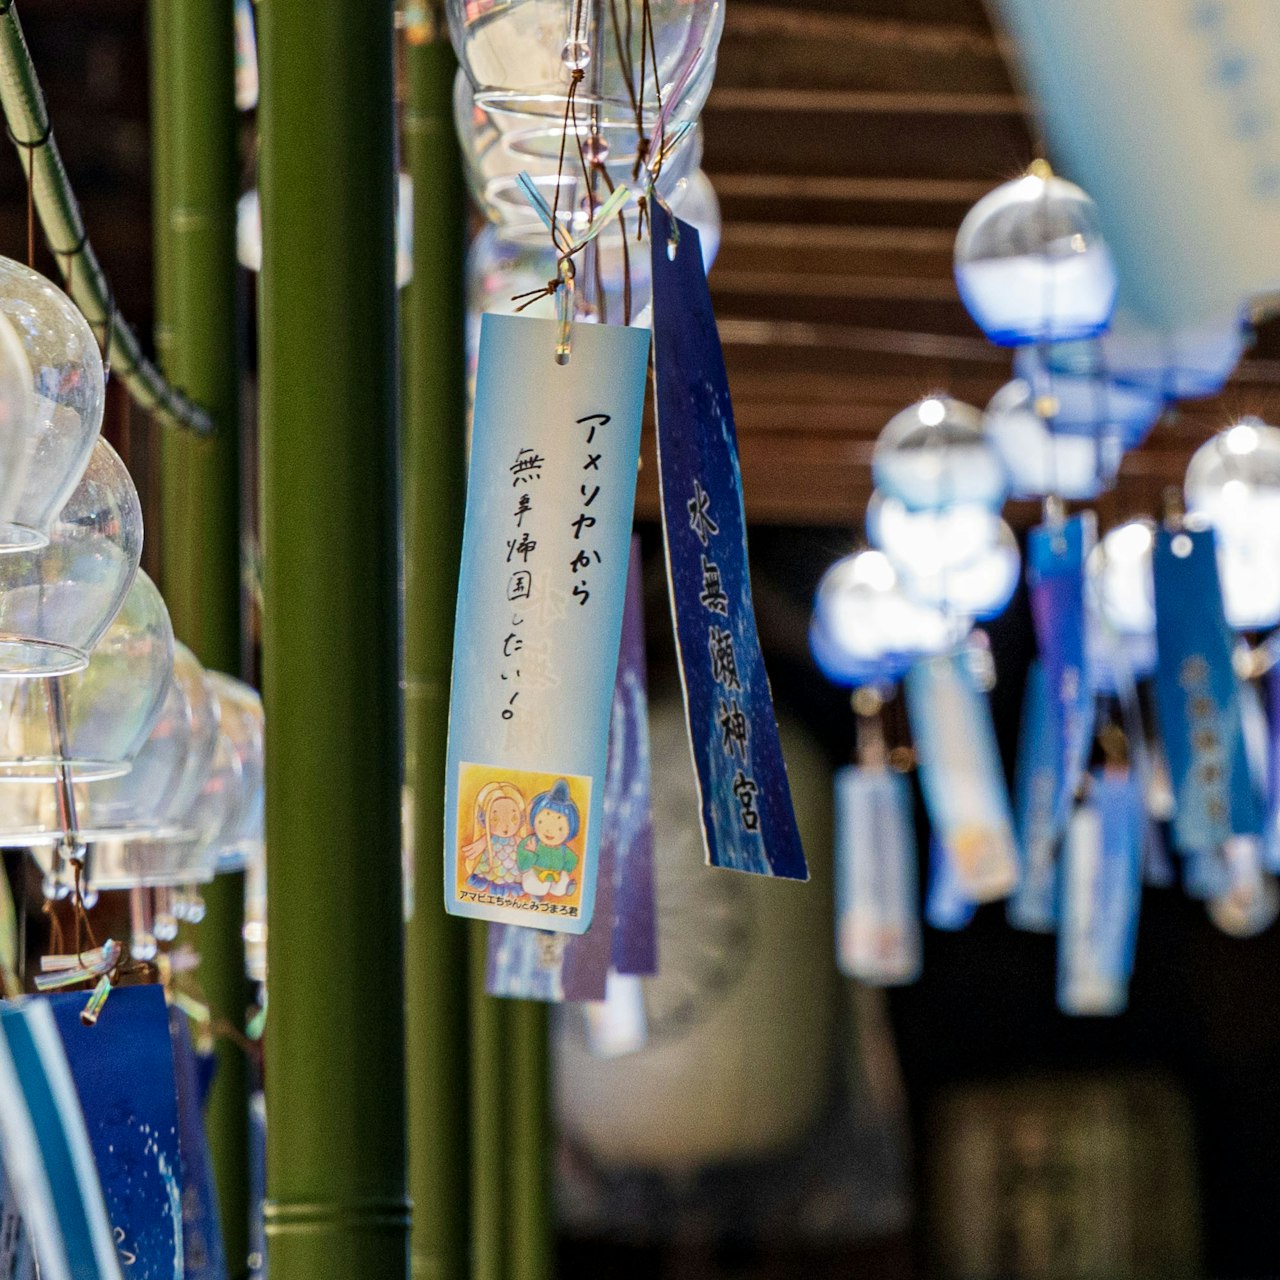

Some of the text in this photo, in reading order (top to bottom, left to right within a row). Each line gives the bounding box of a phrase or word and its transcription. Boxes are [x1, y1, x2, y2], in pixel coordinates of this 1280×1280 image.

[570, 412, 611, 606] アメリカから
[686, 479, 760, 834] 水無瀬神宮
[459, 890, 579, 917] アマビエちゃんとみづまろ君
